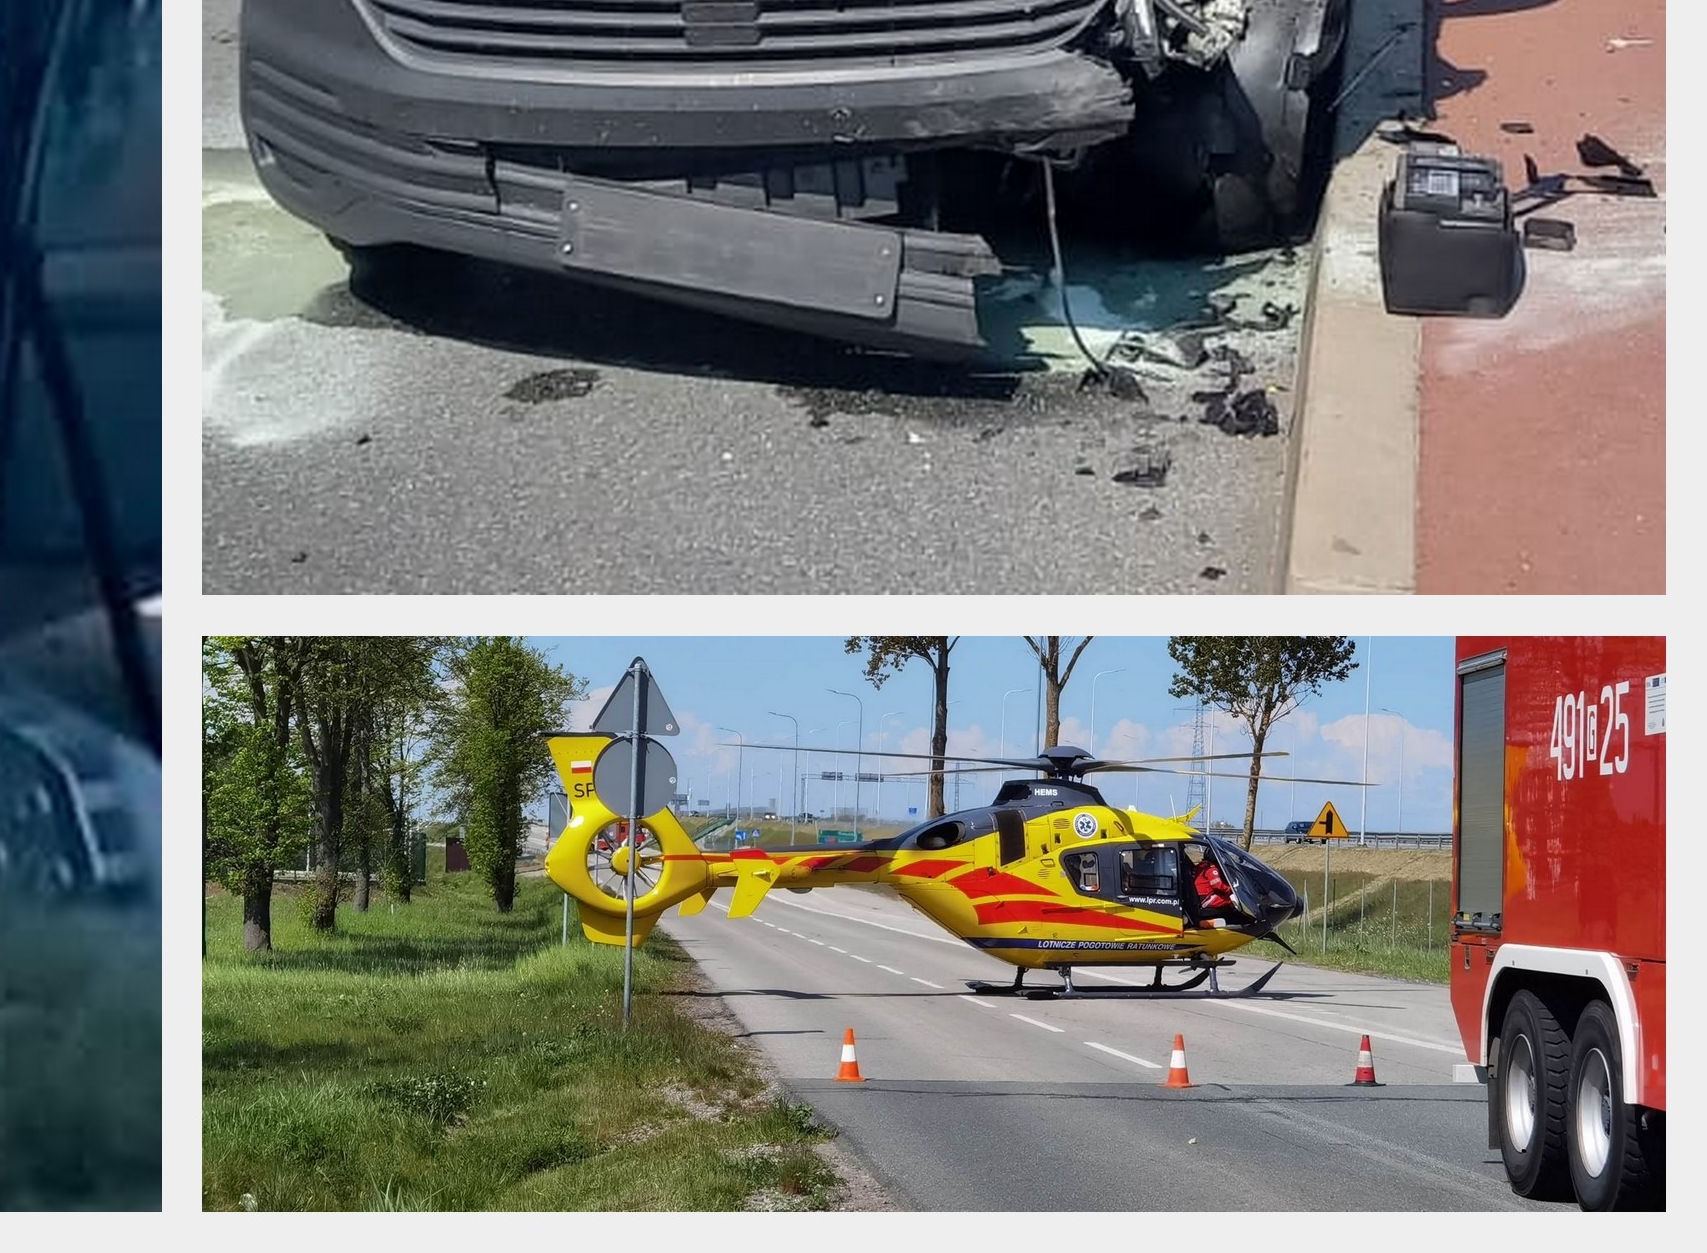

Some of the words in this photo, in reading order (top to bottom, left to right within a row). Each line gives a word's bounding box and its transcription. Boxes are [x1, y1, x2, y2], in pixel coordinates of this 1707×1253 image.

[1034, 788, 1058, 796] HEMS
[1128, 896, 1180, 907] www.lpr.com.pl
[1037, 940, 1076, 949] LOTNICZE
[1077, 941, 1125, 950] POGOTOWIE
[1126, 942, 1176, 951] RATUNKOWE
